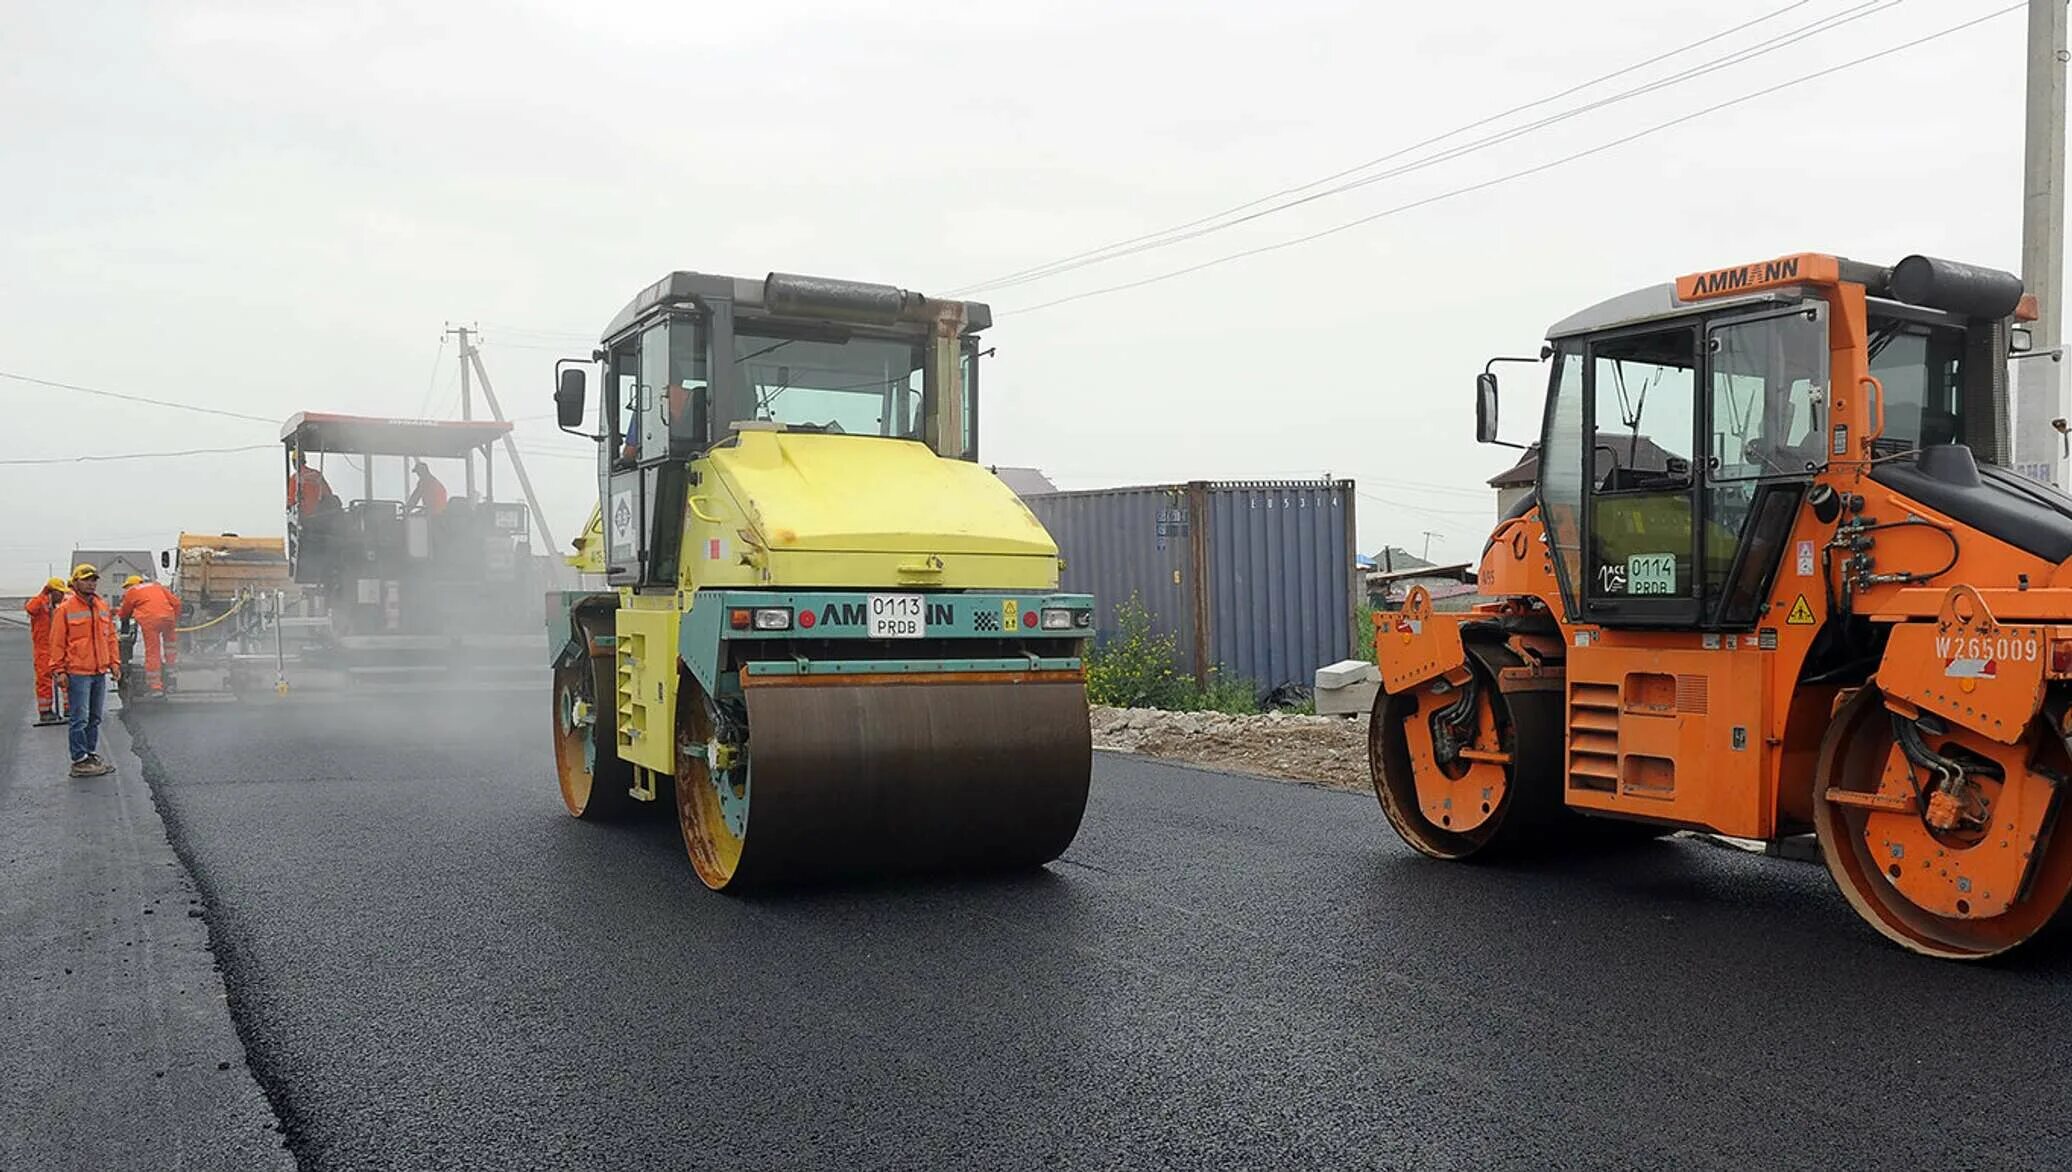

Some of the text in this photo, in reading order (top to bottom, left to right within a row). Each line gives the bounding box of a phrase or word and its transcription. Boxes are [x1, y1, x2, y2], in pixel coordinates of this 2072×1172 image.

[1632, 558, 1671, 577] 0114
[1635, 581, 1668, 595] PRDB
[820, 603, 954, 626] AMN
[873, 598, 920, 616] 0113
[877, 620, 917, 635] PRDB
[1936, 636, 2038, 662] W265009
